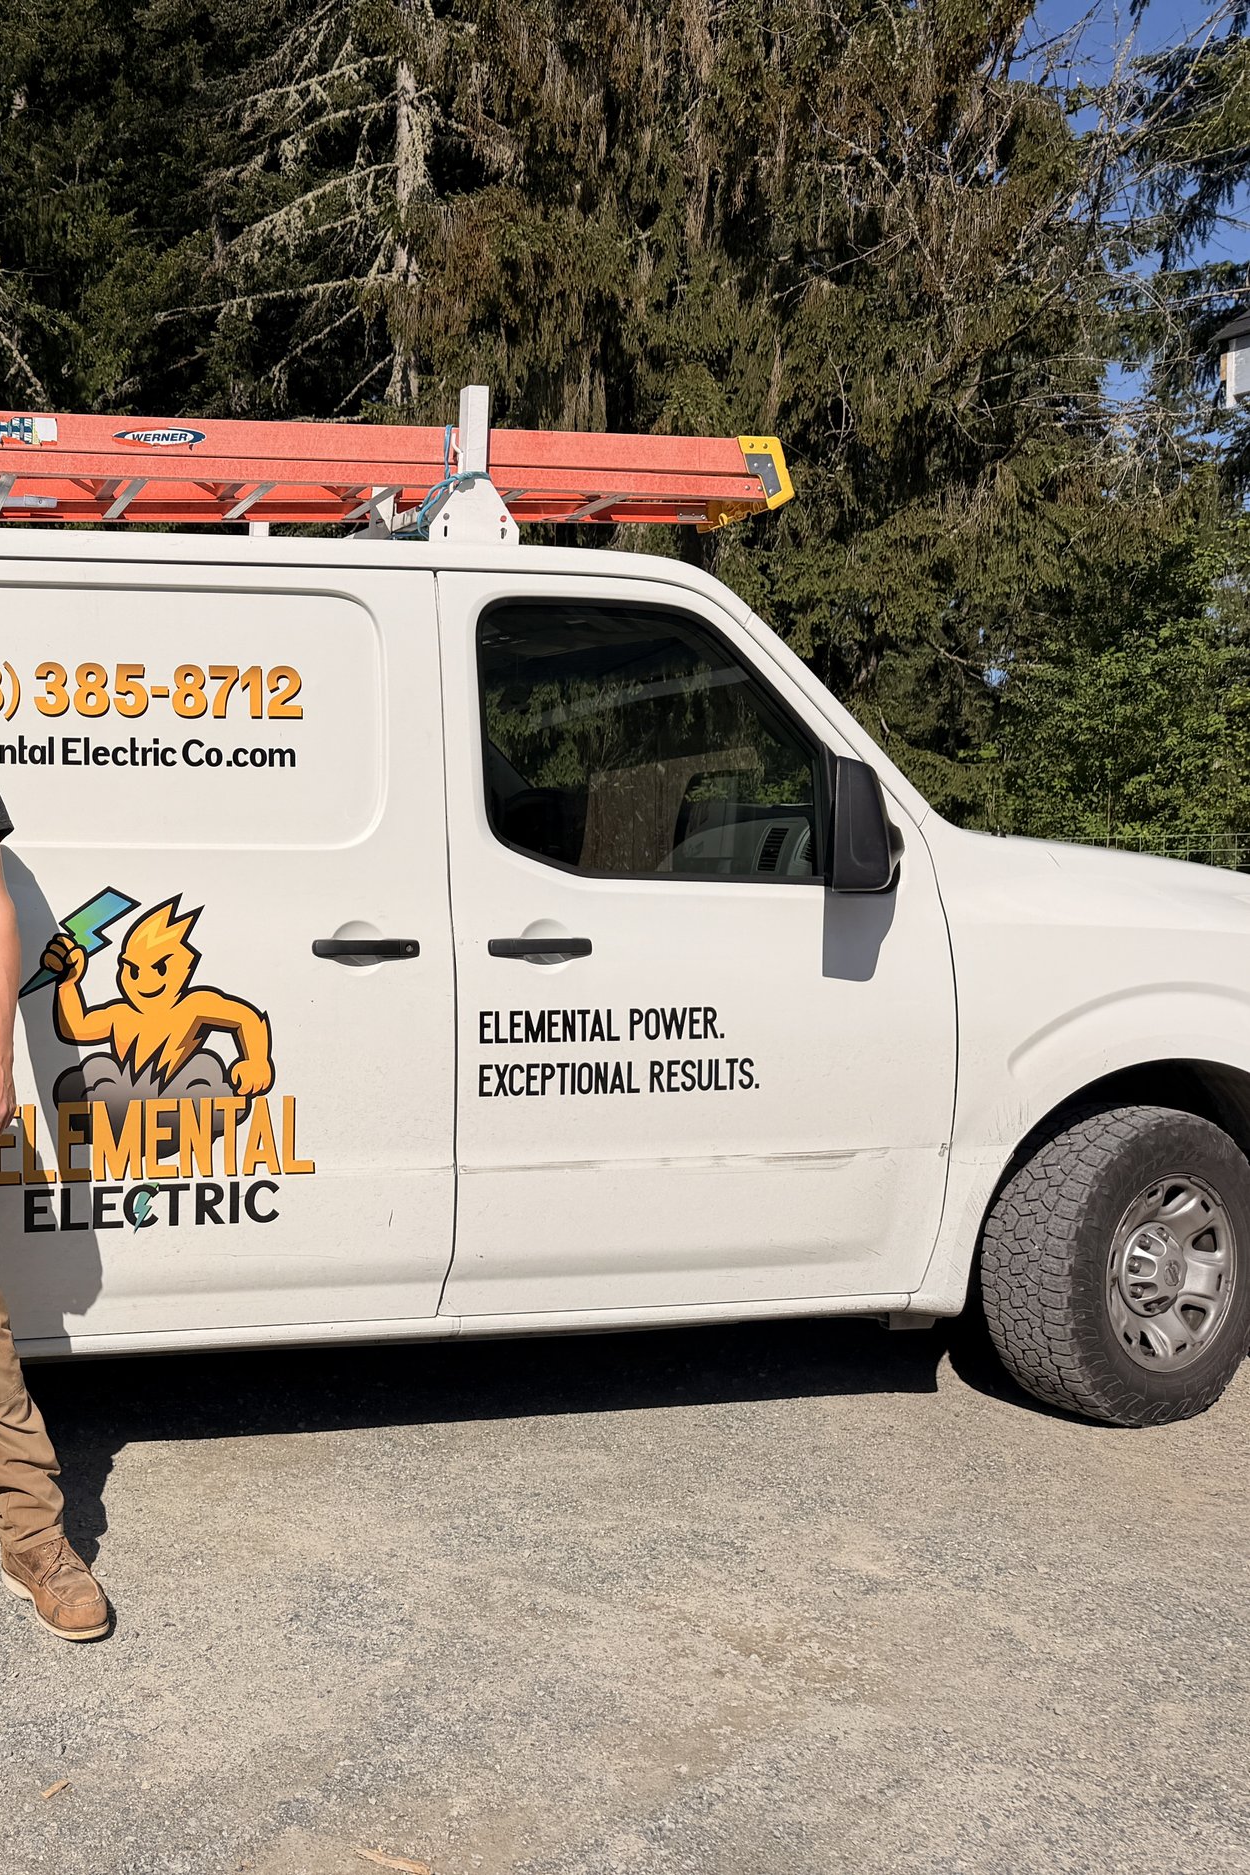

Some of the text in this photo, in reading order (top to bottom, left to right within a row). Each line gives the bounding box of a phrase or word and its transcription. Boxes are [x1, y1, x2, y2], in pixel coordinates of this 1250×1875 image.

[131, 433, 188, 442] WERNER
[33, 661, 304, 720] 385-8712
[478, 1006, 725, 1044] ELEMENTAL POWER.
[478, 1057, 760, 1097] EXCEPTIONAL RESULTS.
[24, 1180, 281, 1233] ELECTRIC
